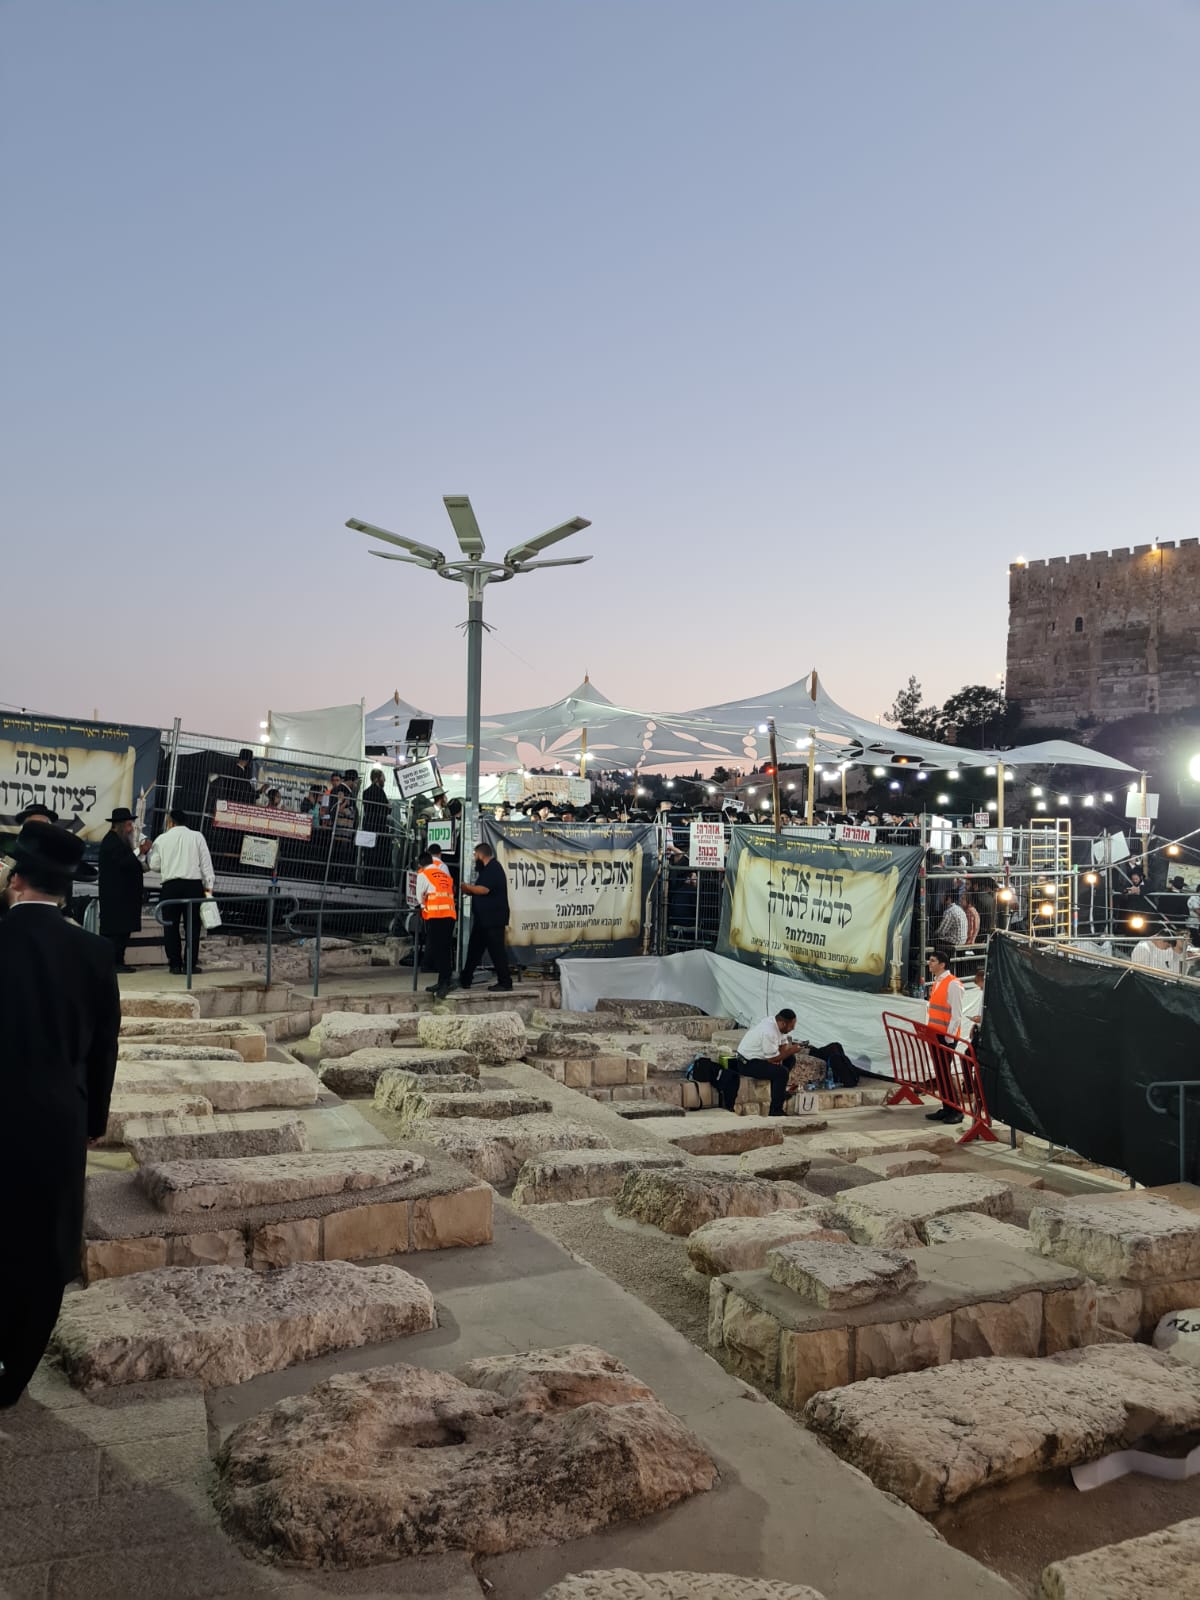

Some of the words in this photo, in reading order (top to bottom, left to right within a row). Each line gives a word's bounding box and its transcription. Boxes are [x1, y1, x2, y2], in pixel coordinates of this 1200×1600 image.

[16, 750, 69, 778] כניסה
[0, 780, 46, 810] הקדו
[52, 785, 96, 812] לציון
[428, 828, 450, 842] כניסה
[842, 826, 870, 841] אזהרה!
[782, 866, 811, 896] ארץ
[816, 873, 844, 898] דרך
[556, 904, 595, 917] התפללת?
[768, 891, 808, 920] לתורה
[810, 898, 852, 929] קדמה
[521, 922, 539, 931] היציאה
[540, 922, 549, 930] עבר
[551, 920, 557, 929] אל
[786, 926, 826, 946] התפללת?
[828, 952, 849, 964] התחשב
